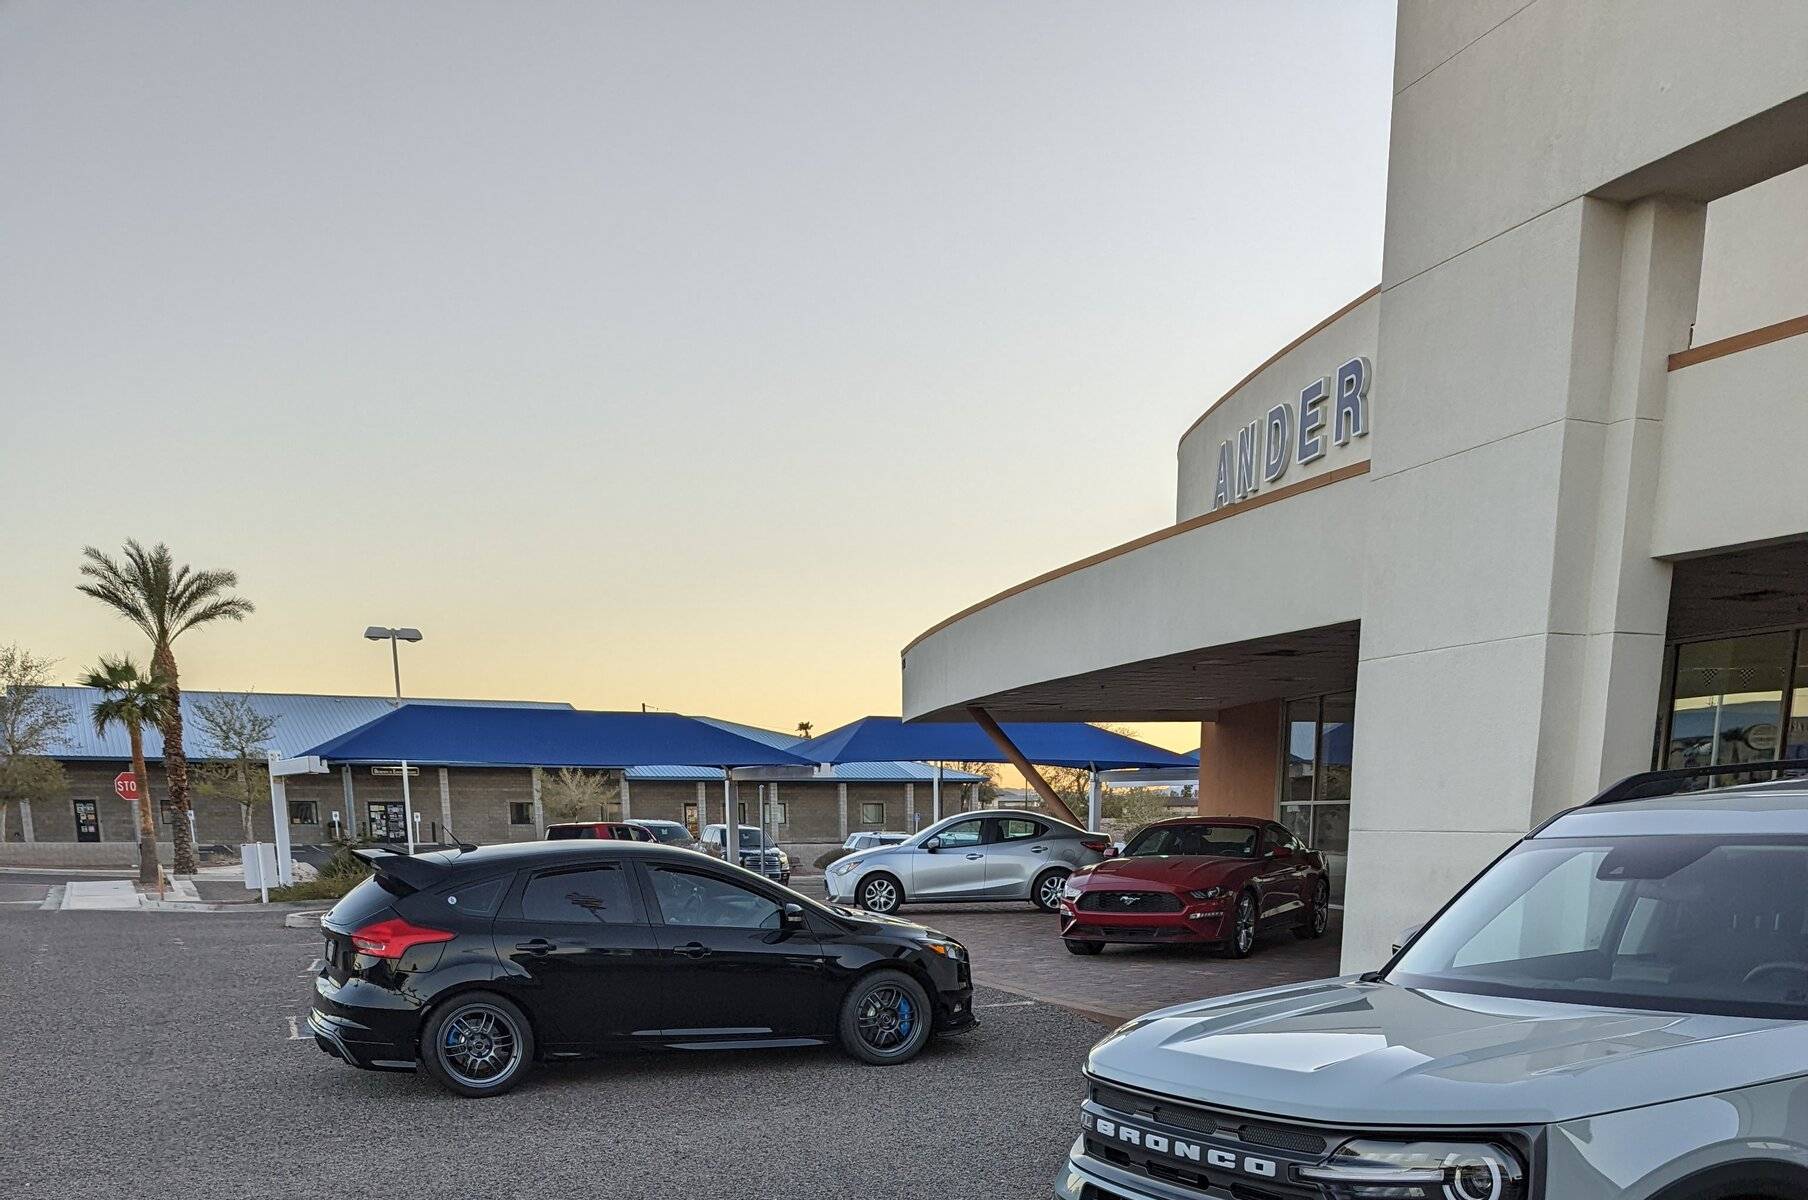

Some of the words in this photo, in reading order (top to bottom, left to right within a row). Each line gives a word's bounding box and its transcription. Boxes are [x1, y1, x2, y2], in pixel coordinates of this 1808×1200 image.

[1212, 357, 1372, 511] ANDER
[117, 780, 137, 792] STO
[1096, 1118, 1276, 1177] BRONCO
